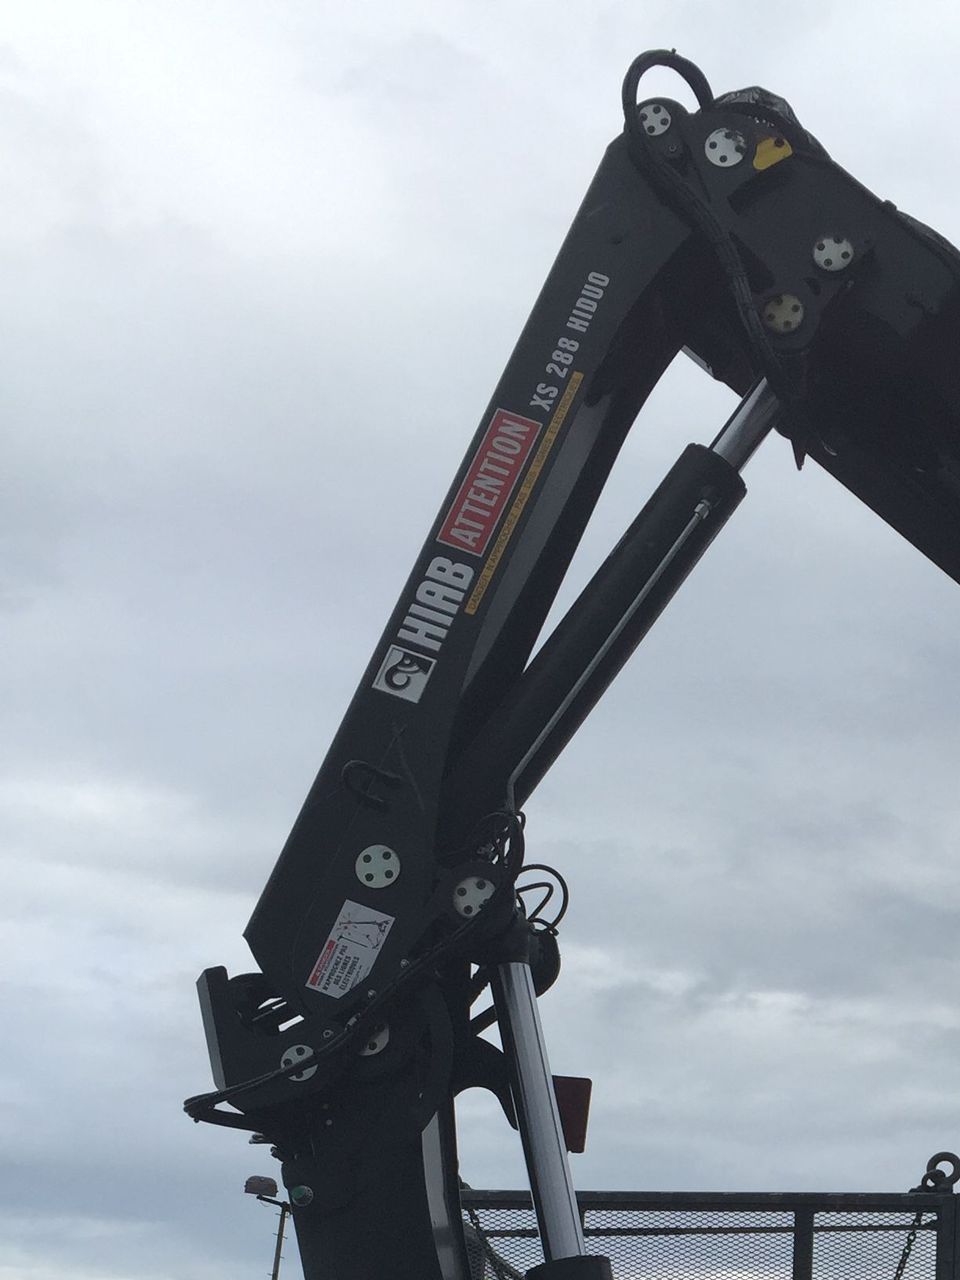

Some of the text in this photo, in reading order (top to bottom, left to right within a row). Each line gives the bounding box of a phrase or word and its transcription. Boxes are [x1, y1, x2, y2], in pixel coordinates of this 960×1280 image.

[529, 271, 611, 412] XS 288 HIDUO
[451, 418, 530, 548] ATTENTION
[398, 555, 475, 652] HIAB
